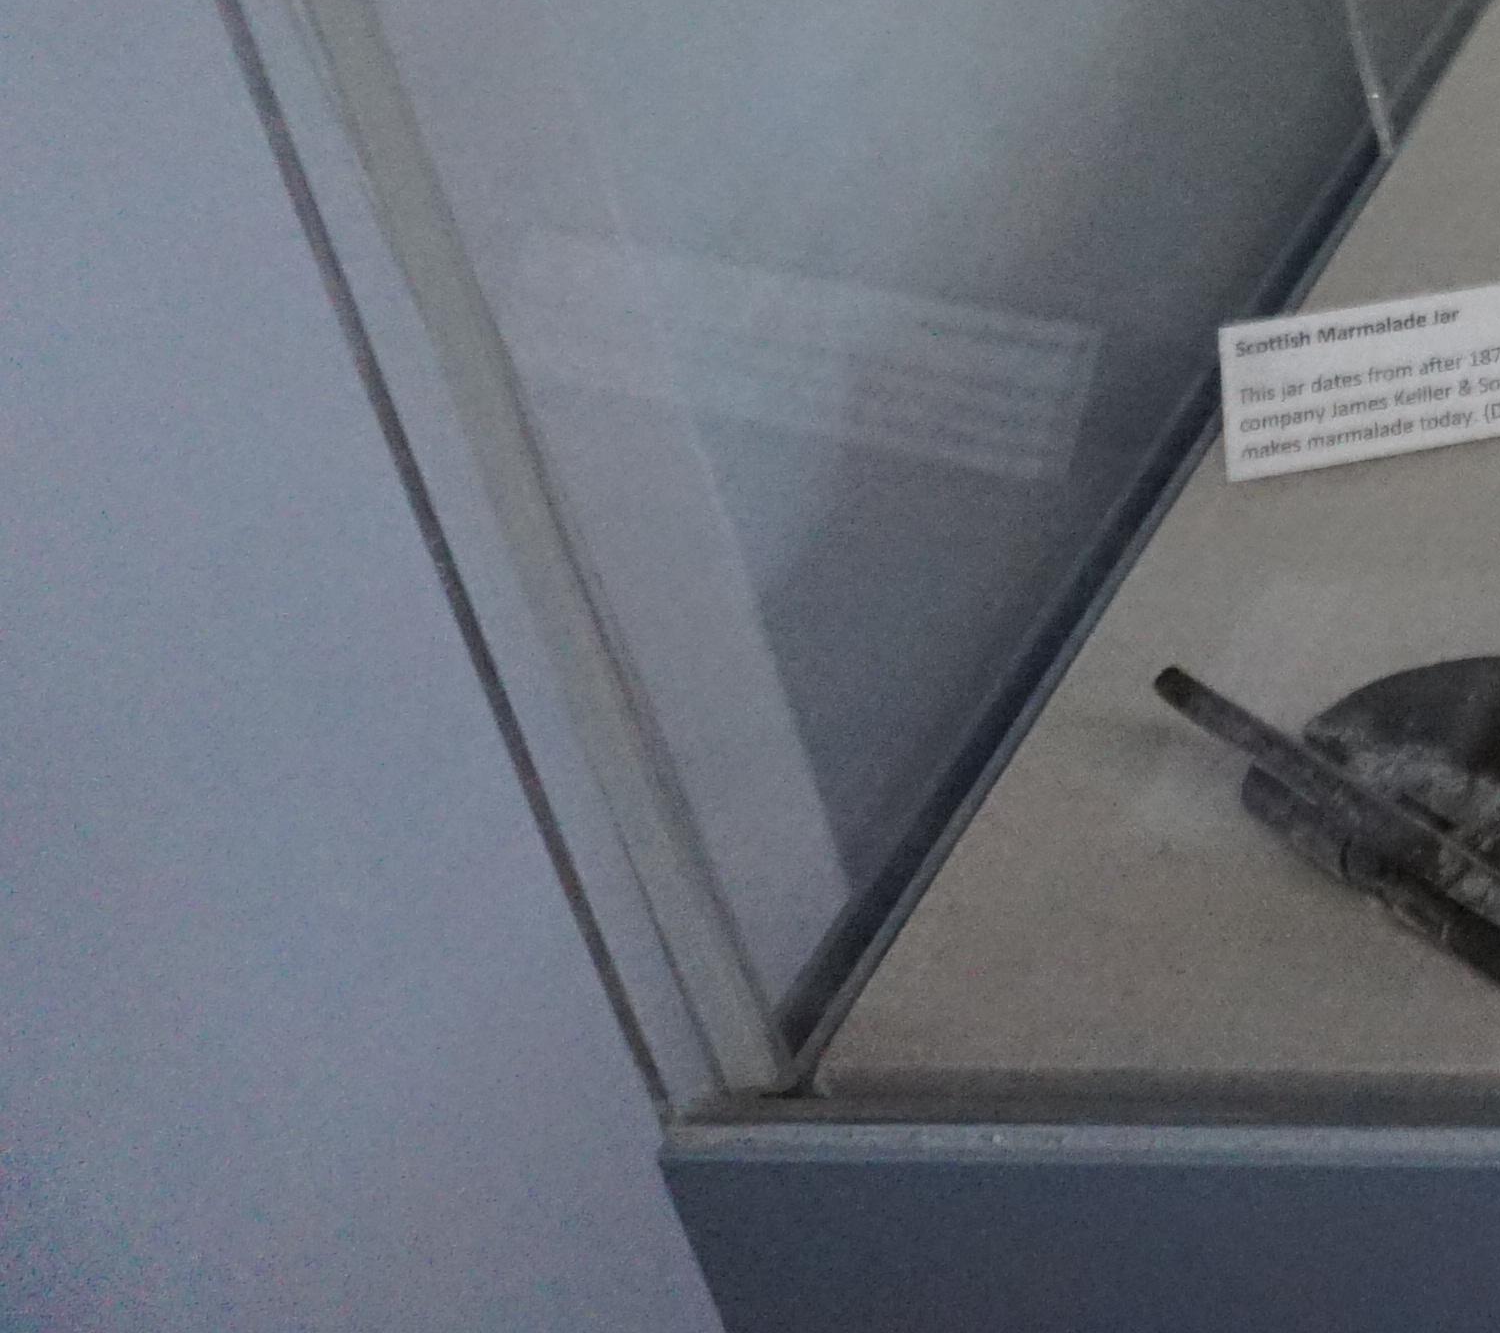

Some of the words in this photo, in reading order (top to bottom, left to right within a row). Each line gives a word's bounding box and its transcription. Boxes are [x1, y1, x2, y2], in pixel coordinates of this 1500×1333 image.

[1233, 328, 1312, 358] Scottish
[1315, 311, 1428, 344] Marmalade
[1431, 307, 1461, 325] Jar
[1239, 437, 1302, 460] makes
[1305, 417, 1416, 449] marmalade
[1418, 410, 1479, 431] today.
